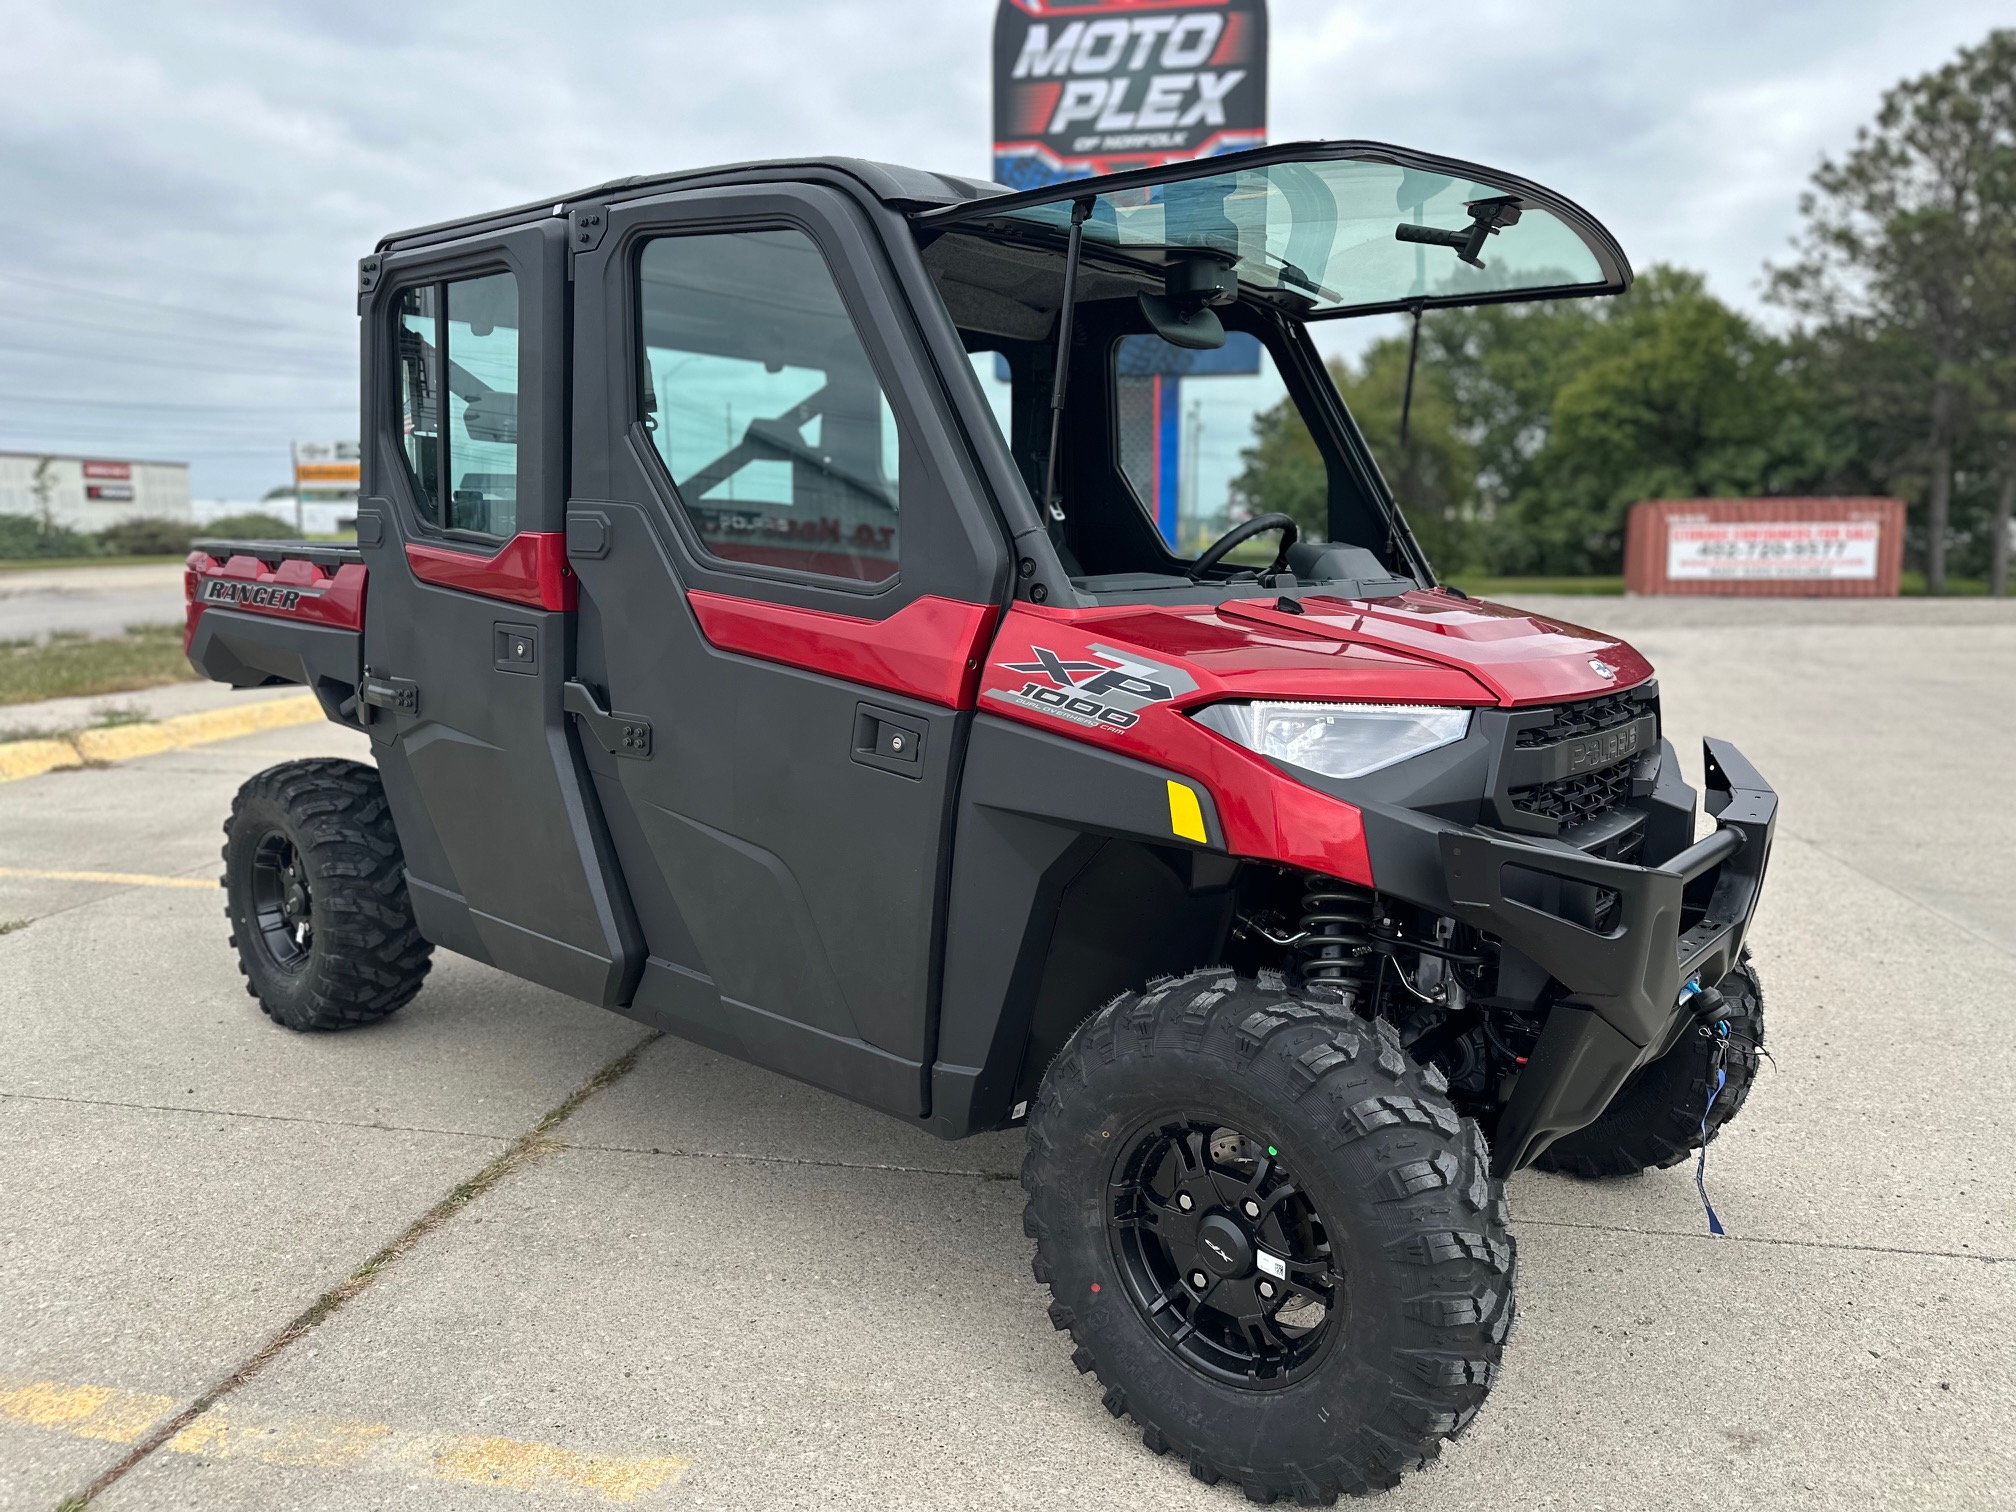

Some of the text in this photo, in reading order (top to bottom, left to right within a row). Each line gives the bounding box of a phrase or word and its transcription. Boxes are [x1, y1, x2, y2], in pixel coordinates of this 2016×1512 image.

[1011, 12, 1224, 79] MOTO
[1048, 69, 1247, 134] PLEX
[1072, 130, 1189, 152] OF NORFOLK
[206, 580, 301, 611] RANGER
[994, 644, 1176, 703] XP
[1015, 698, 1126, 736] DUAL OVERHEAD CAM
[1017, 681, 1141, 730] 1000
[1570, 726, 1638, 771] POLARIS
[1204, 1238, 1234, 1263] XP
